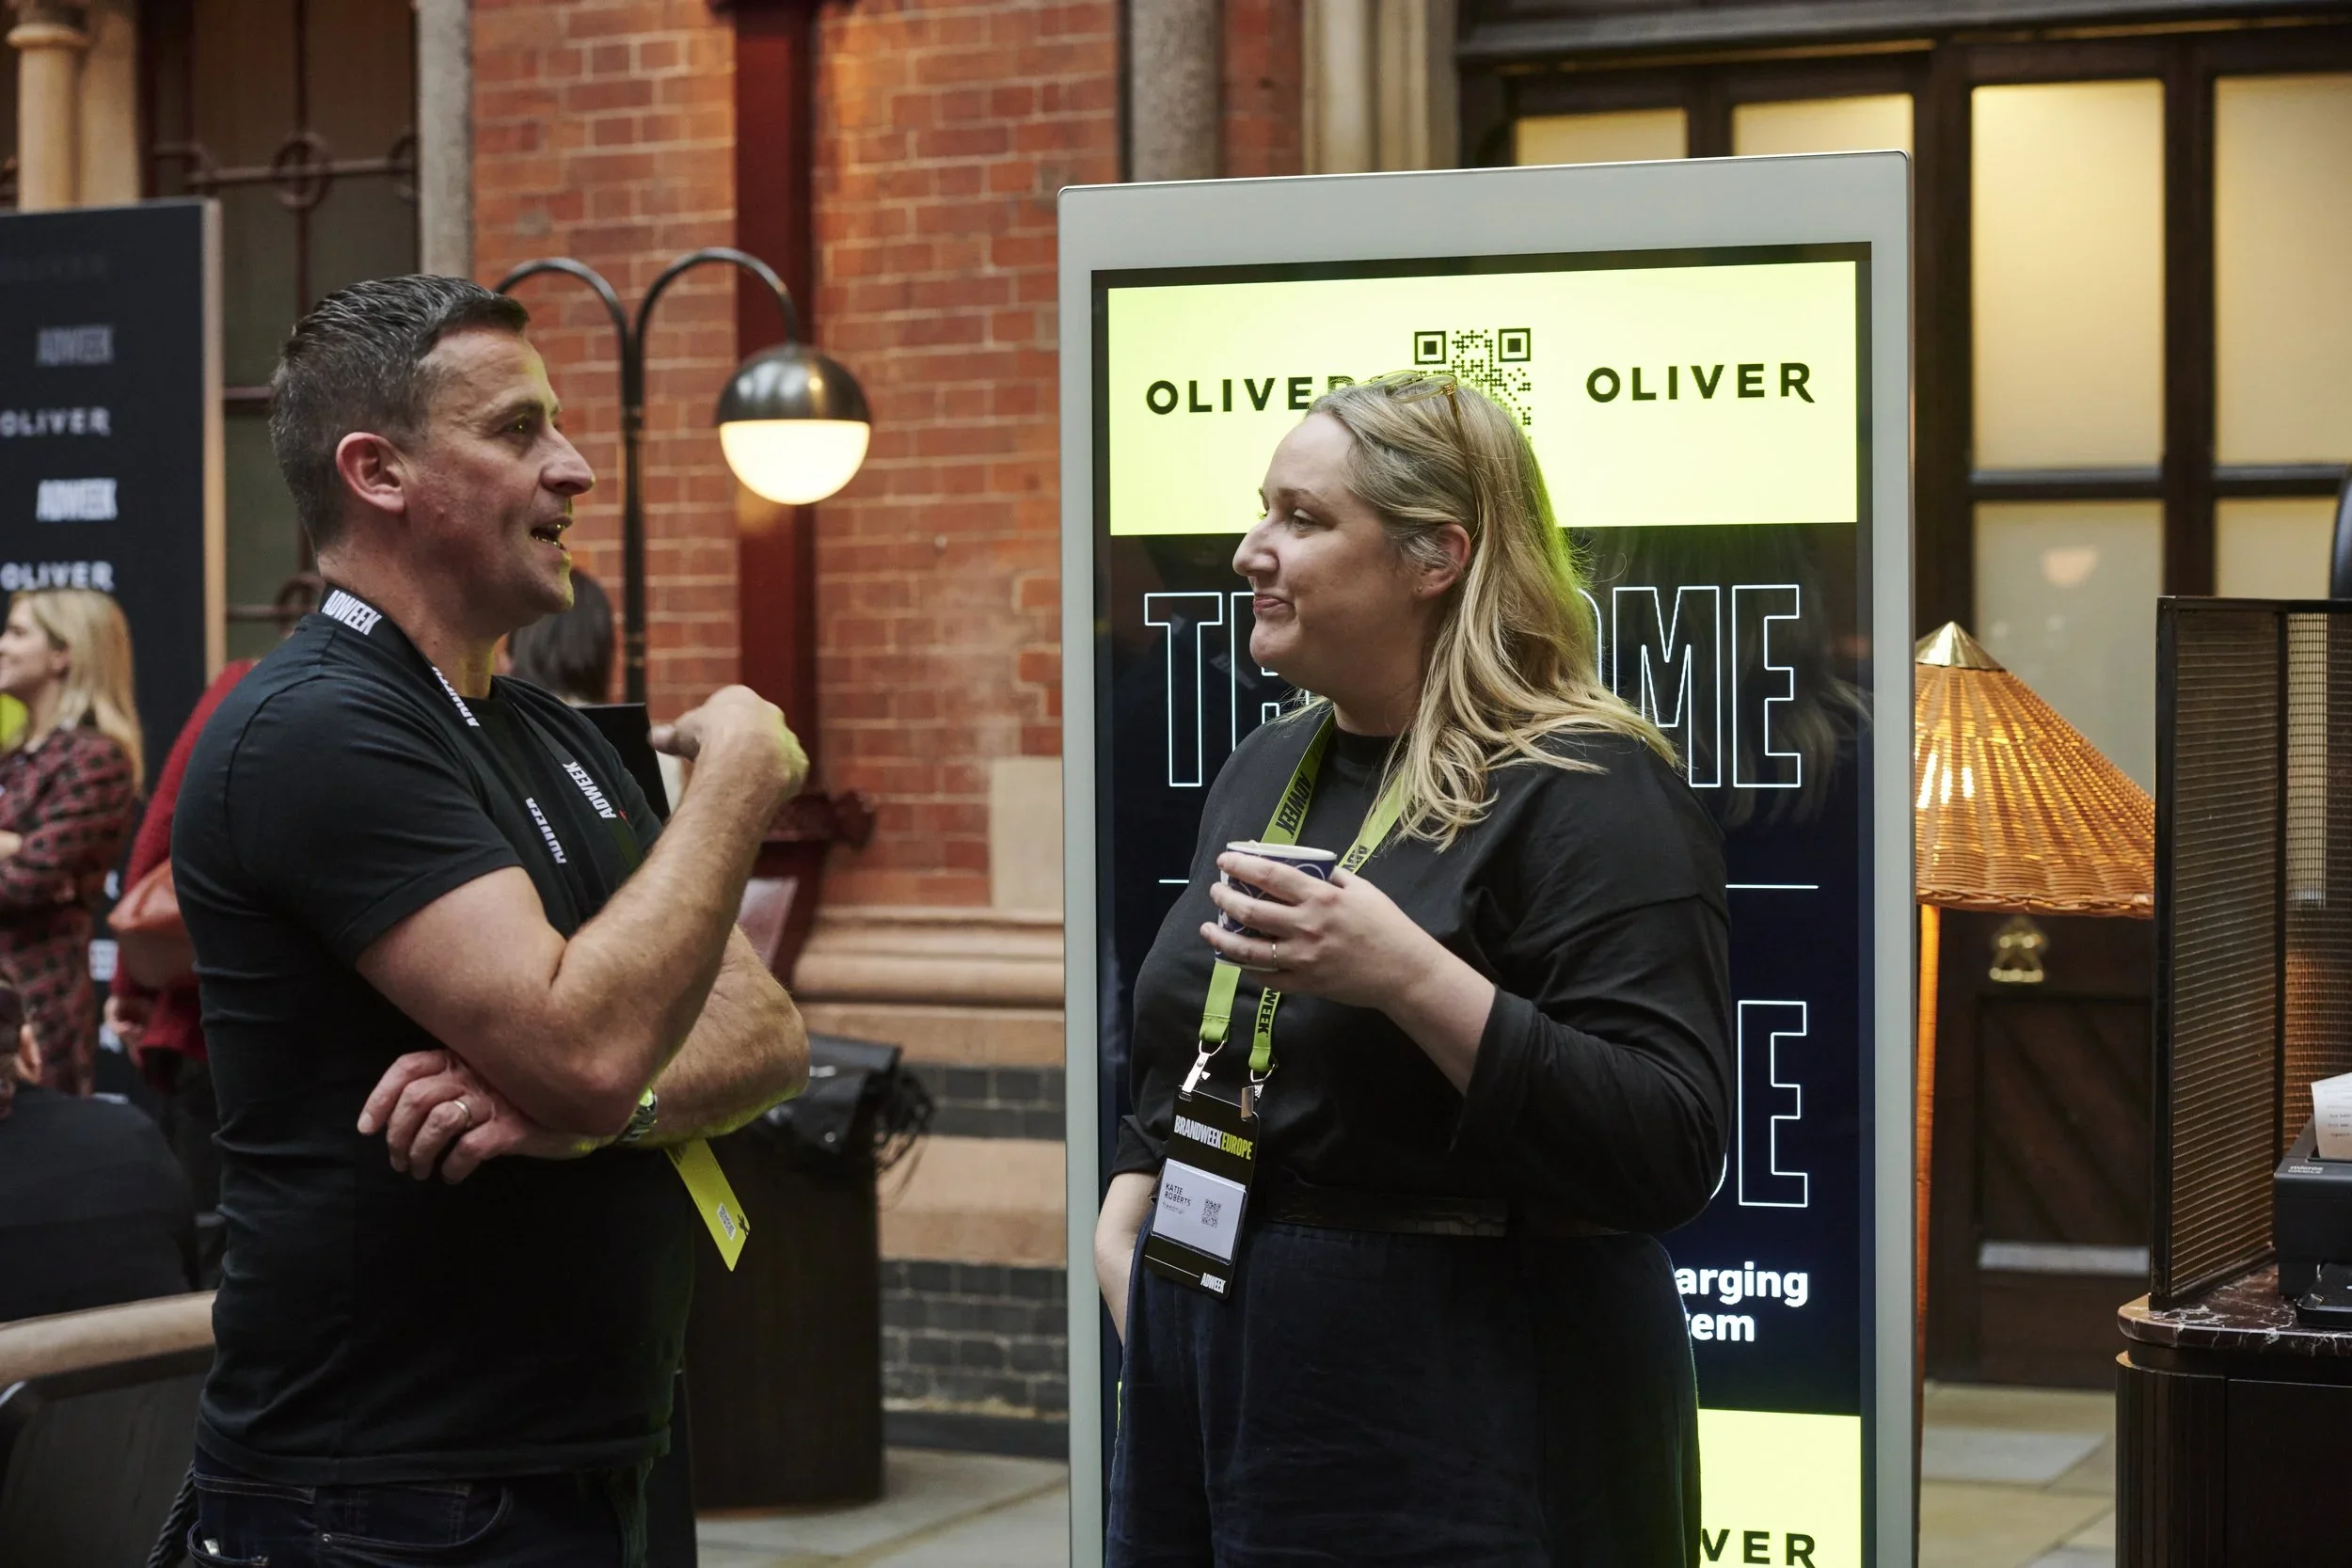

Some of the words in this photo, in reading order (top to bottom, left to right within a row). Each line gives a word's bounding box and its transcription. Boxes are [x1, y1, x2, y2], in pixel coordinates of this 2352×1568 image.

[1586, 362, 1815, 404] OLIVER
[0, 407, 111, 437] OLIVER
[0, 561, 116, 593] OLIVER
[322, 590, 382, 636] ADWEEK
[563, 761, 617, 818] ADWEEK
[1275, 768, 1311, 836] ADWEEK
[1258, 987, 1278, 1034] WEEK
[1165, 1191, 1191, 1207] ROBERTS
[1166, 1182, 1184, 1196] KATIE
[1200, 1272, 1227, 1294] ADWEEK
[1673, 1260, 1808, 1307] arging
[1701, 1528, 1816, 1568] VER
